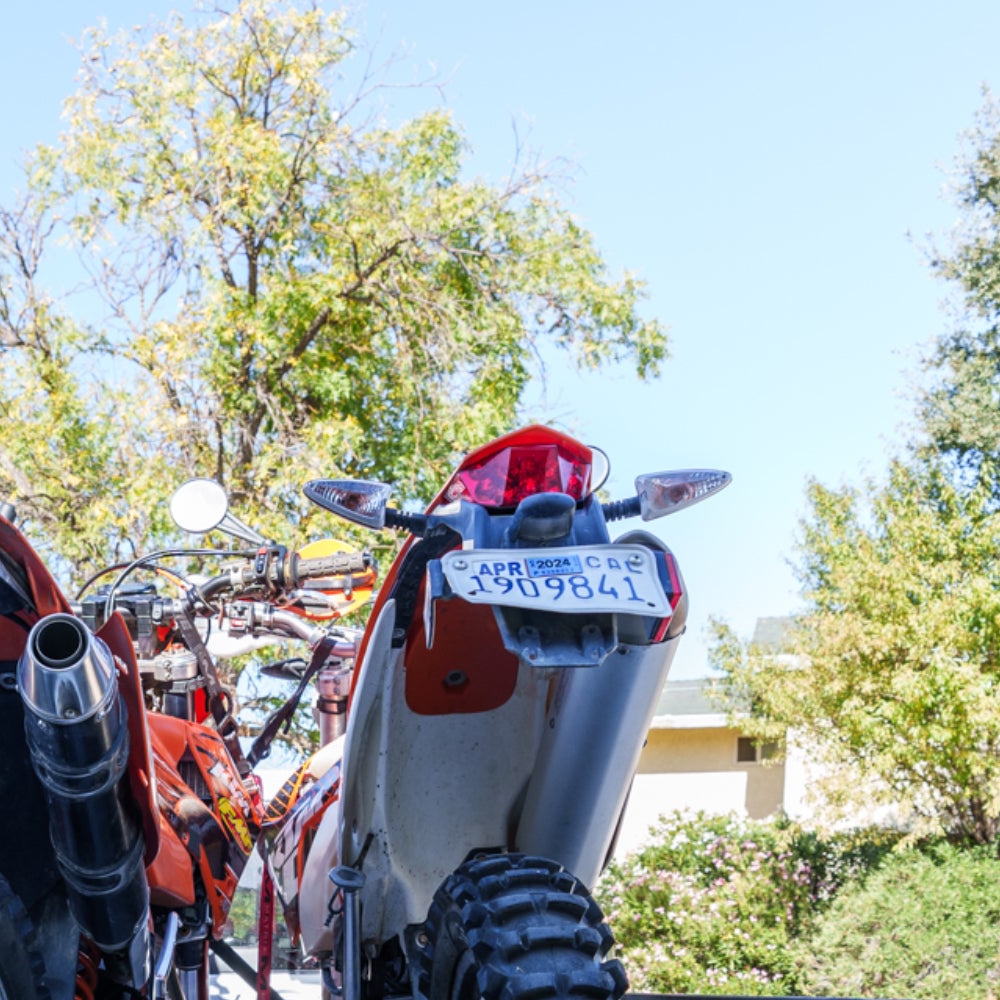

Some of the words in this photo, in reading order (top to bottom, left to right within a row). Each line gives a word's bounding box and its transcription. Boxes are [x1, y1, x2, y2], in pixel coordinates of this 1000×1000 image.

[479, 562, 523, 576] APR
[536, 559, 571, 569] 2024
[585, 556, 643, 574] CAL
[262, 904, 270, 952] MATRIX
